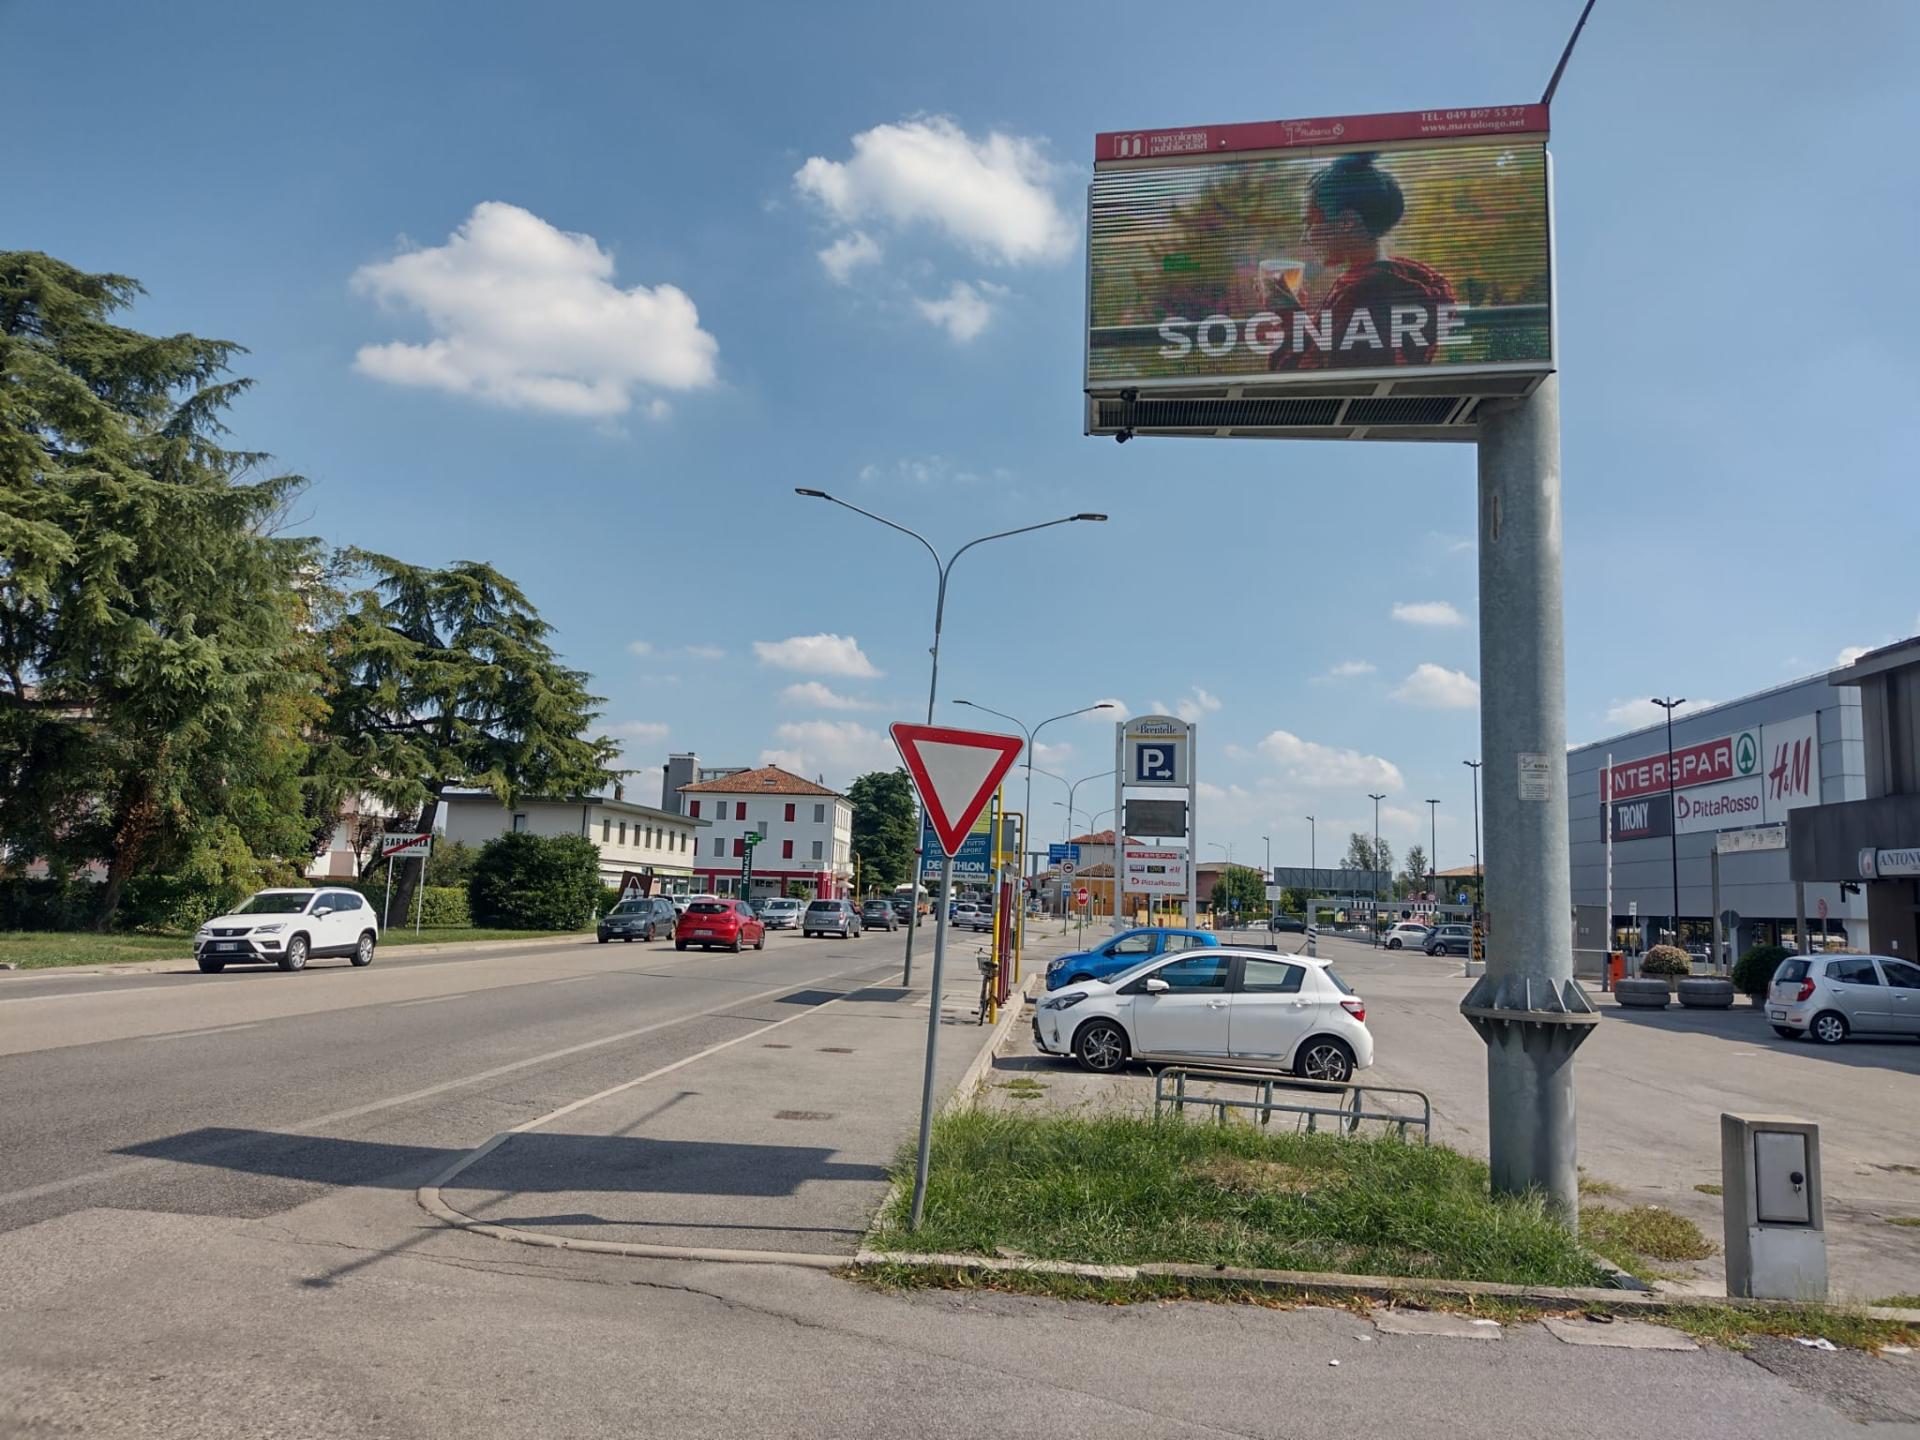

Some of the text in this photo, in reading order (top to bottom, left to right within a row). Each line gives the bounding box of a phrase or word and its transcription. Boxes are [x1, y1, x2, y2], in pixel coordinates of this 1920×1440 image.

[1421, 112, 1443, 121] TEL.
[1446, 110, 1467, 119] 049
[1470, 109, 1490, 118] 897
[1421, 119, 1525, 132] www.marcolongo.net
[1157, 303, 1473, 360] SOGNARE
[1143, 749, 1165, 777] P
[1611, 747, 1730, 792] NTERSPAR
[1769, 736, 1812, 800] H&M
[1618, 802, 1649, 832] TRONY
[1692, 795, 1759, 818] PittaRosso
[927, 860, 985, 872] DETHLON
